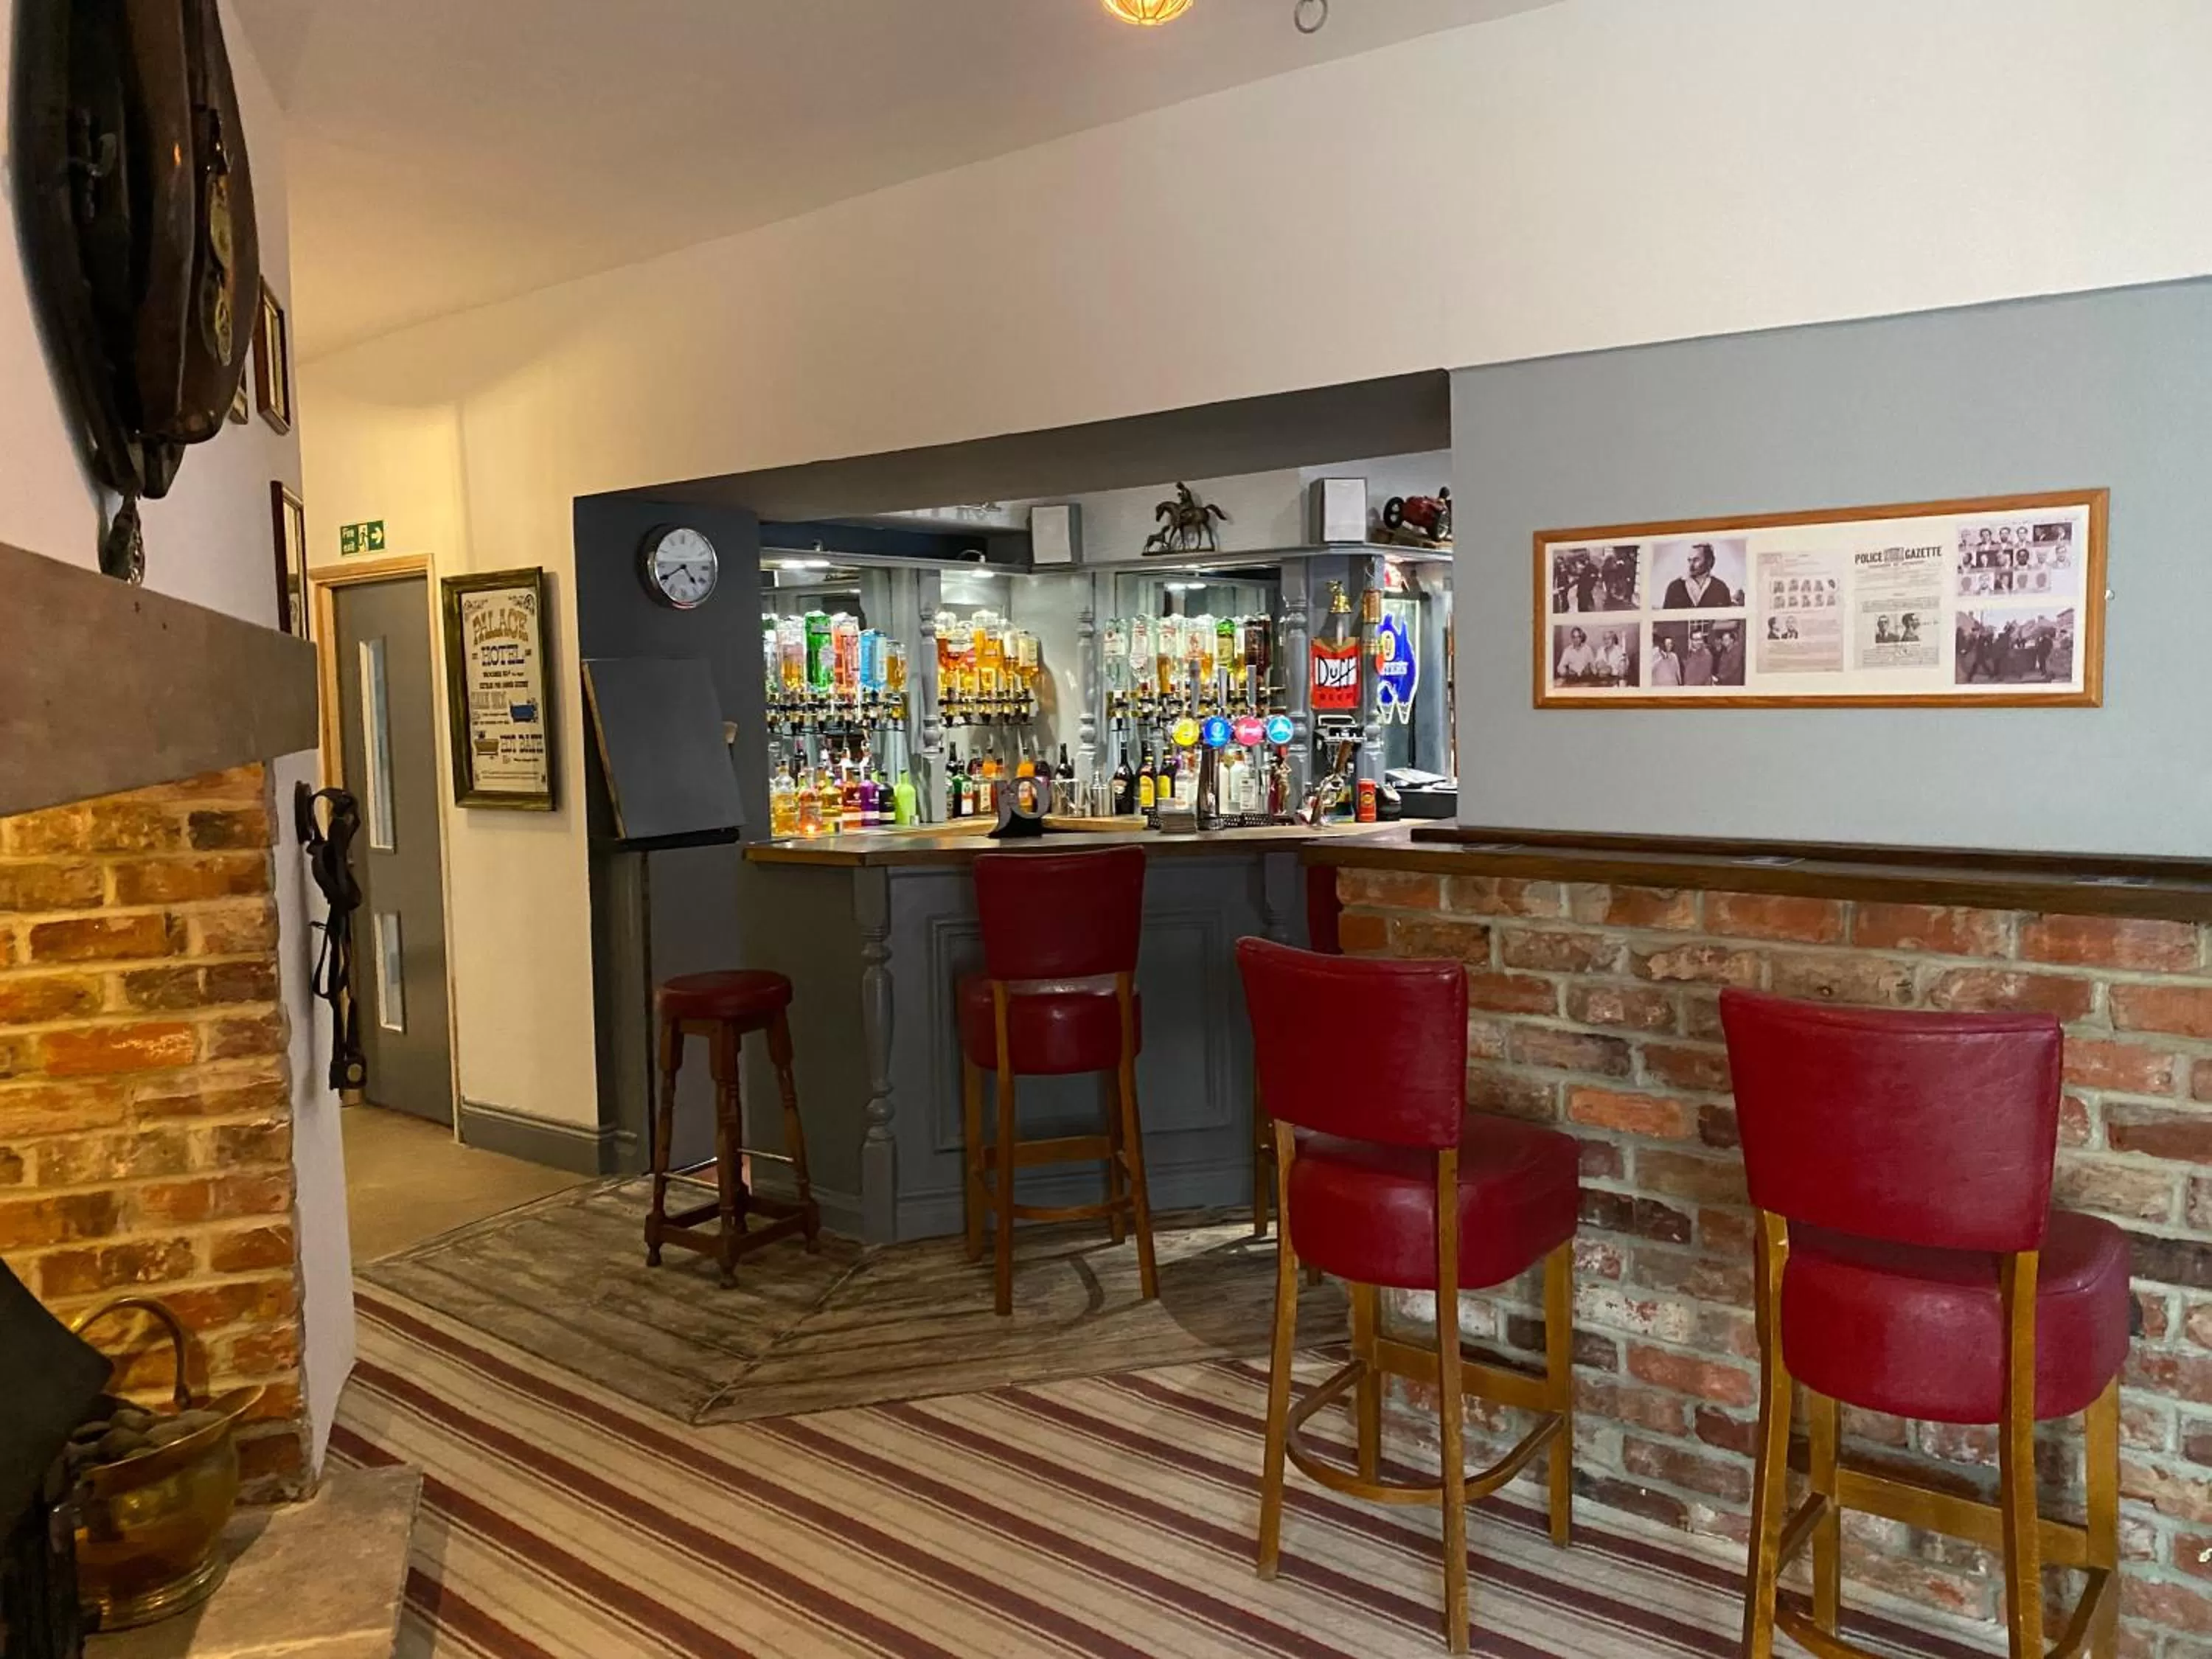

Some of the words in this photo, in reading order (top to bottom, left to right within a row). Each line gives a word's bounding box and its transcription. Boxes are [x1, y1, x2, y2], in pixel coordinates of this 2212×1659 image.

[1854, 552, 1882, 564] POLICE
[1905, 546, 1942, 559] GAZETTE
[472, 608, 529, 644] PALACE
[481, 644, 524, 667] HOTEL
